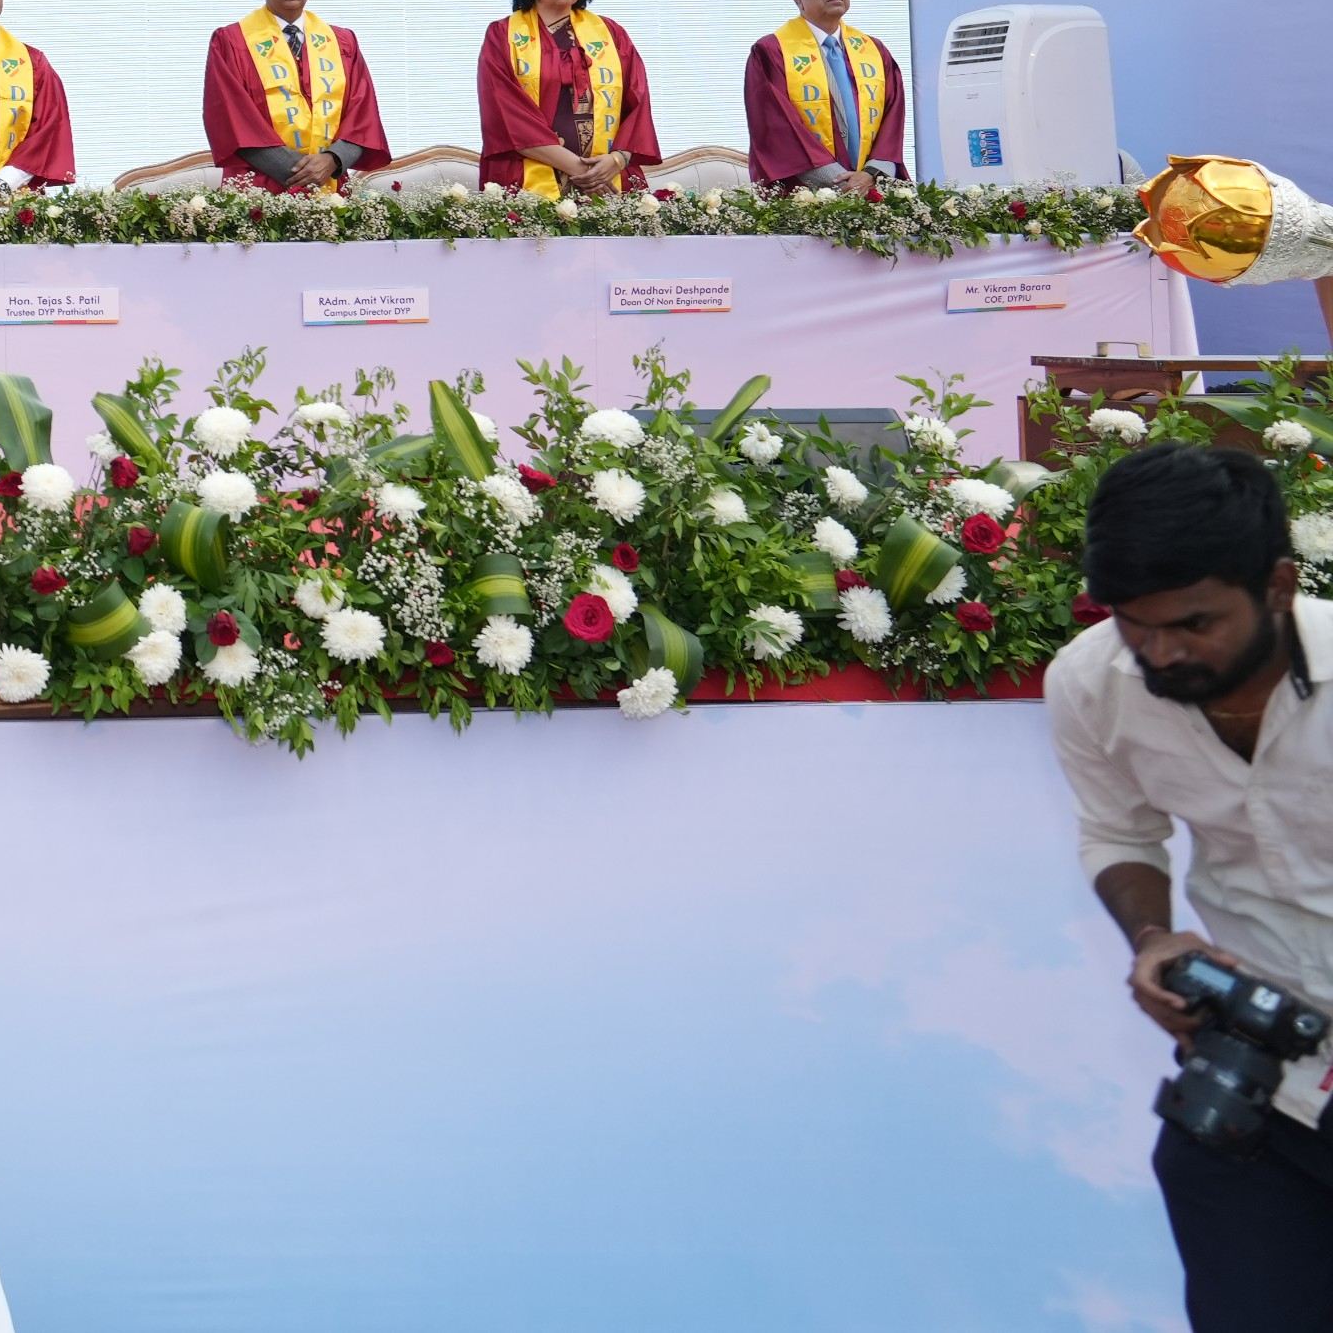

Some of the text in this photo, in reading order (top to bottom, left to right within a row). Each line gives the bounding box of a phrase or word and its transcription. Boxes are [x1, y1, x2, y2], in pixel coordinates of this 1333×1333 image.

[615, 285, 729, 295] Dr. Madhavi Deshpande
[965, 286, 980, 294] Mr.
[983, 285, 1016, 293] Vikram
[9, 296, 100, 306] Hon. Tejas S. Patil
[319, 296, 414, 306] RAdm. Amit Vikram
[676, 298, 722, 306] Engineering
[984, 296, 1005, 304] COE,
[6, 308, 35, 316] Trustee
[38, 308, 55, 316] DYP
[324, 309, 357, 317] Campus
[360, 308, 392, 316] Director
